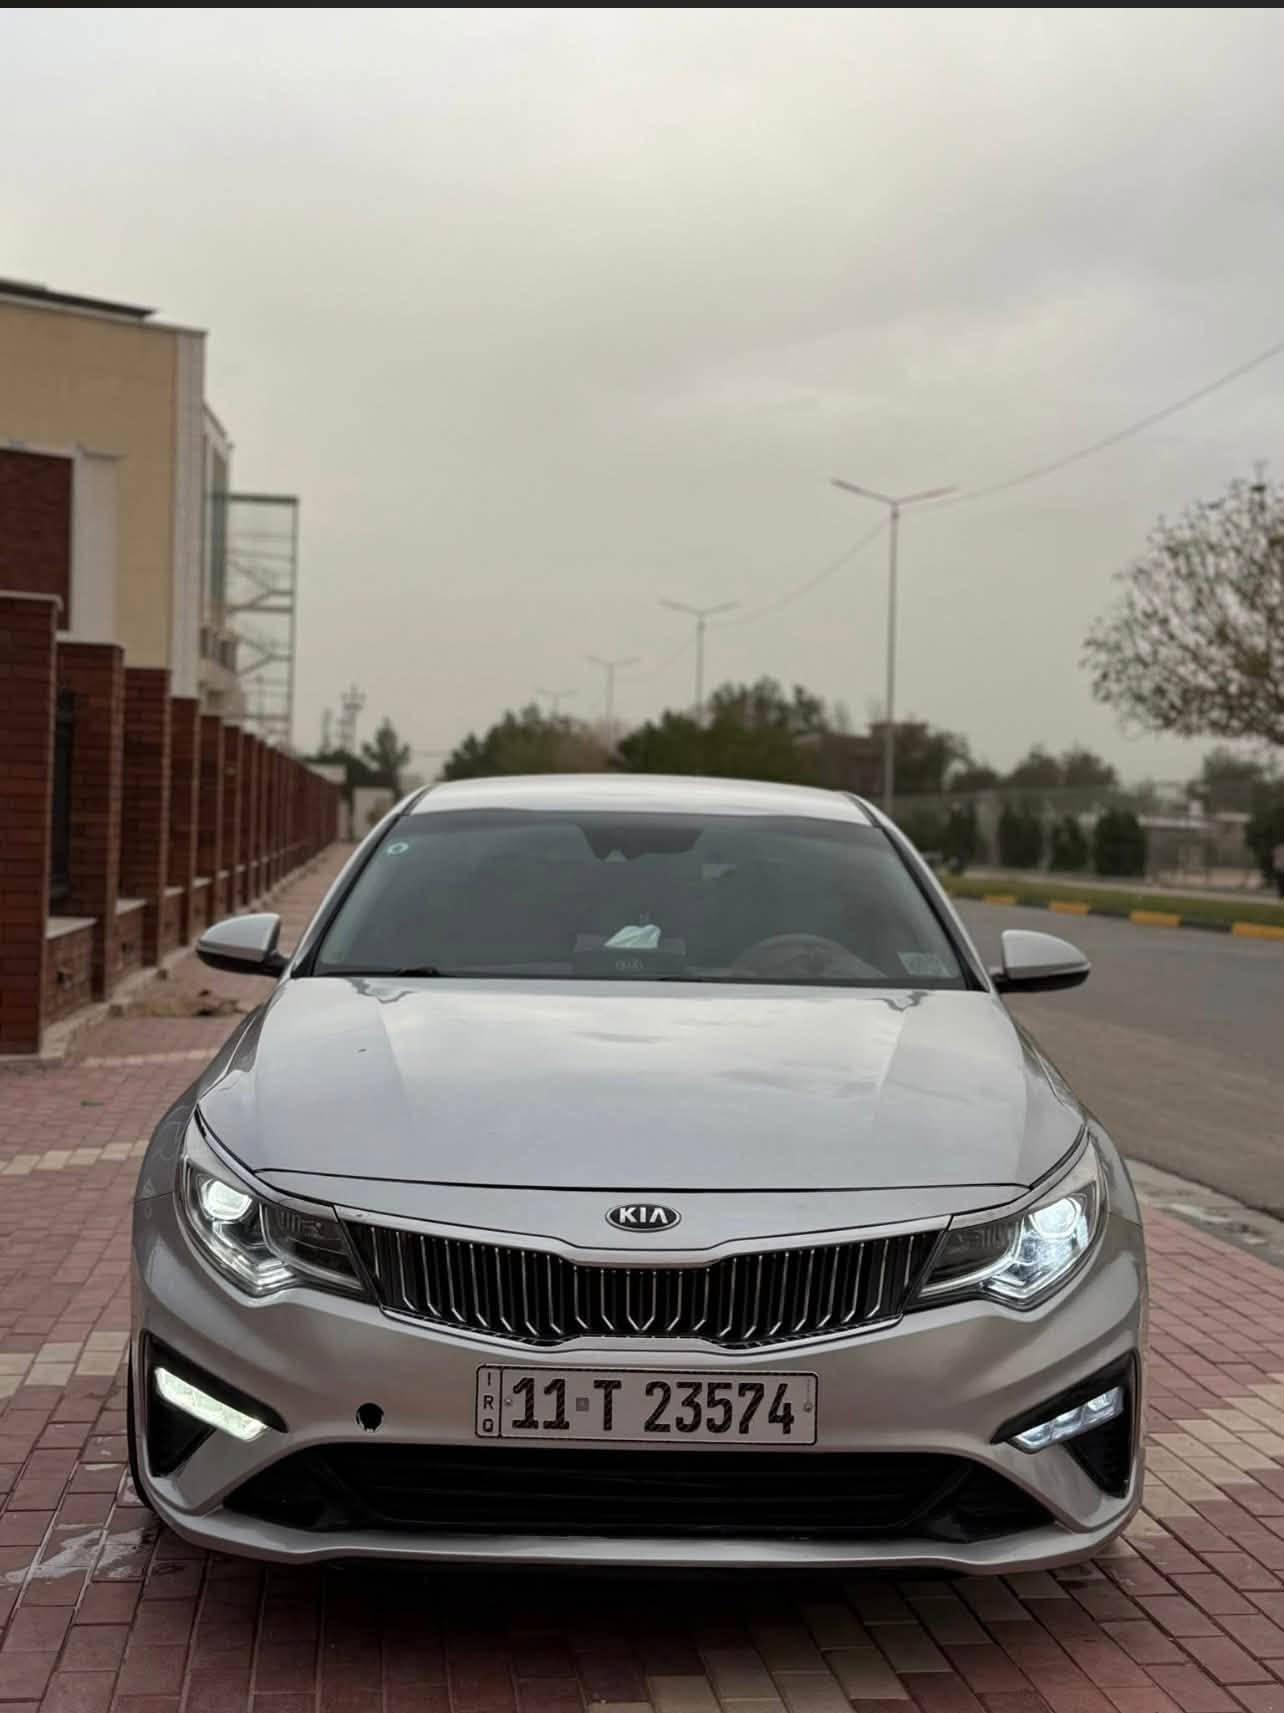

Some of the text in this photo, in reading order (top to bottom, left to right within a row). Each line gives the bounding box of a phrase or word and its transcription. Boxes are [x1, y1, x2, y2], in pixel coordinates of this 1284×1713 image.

[620, 1207, 669, 1224] KIA
[512, 1377, 795, 1435] 11 T 23574
